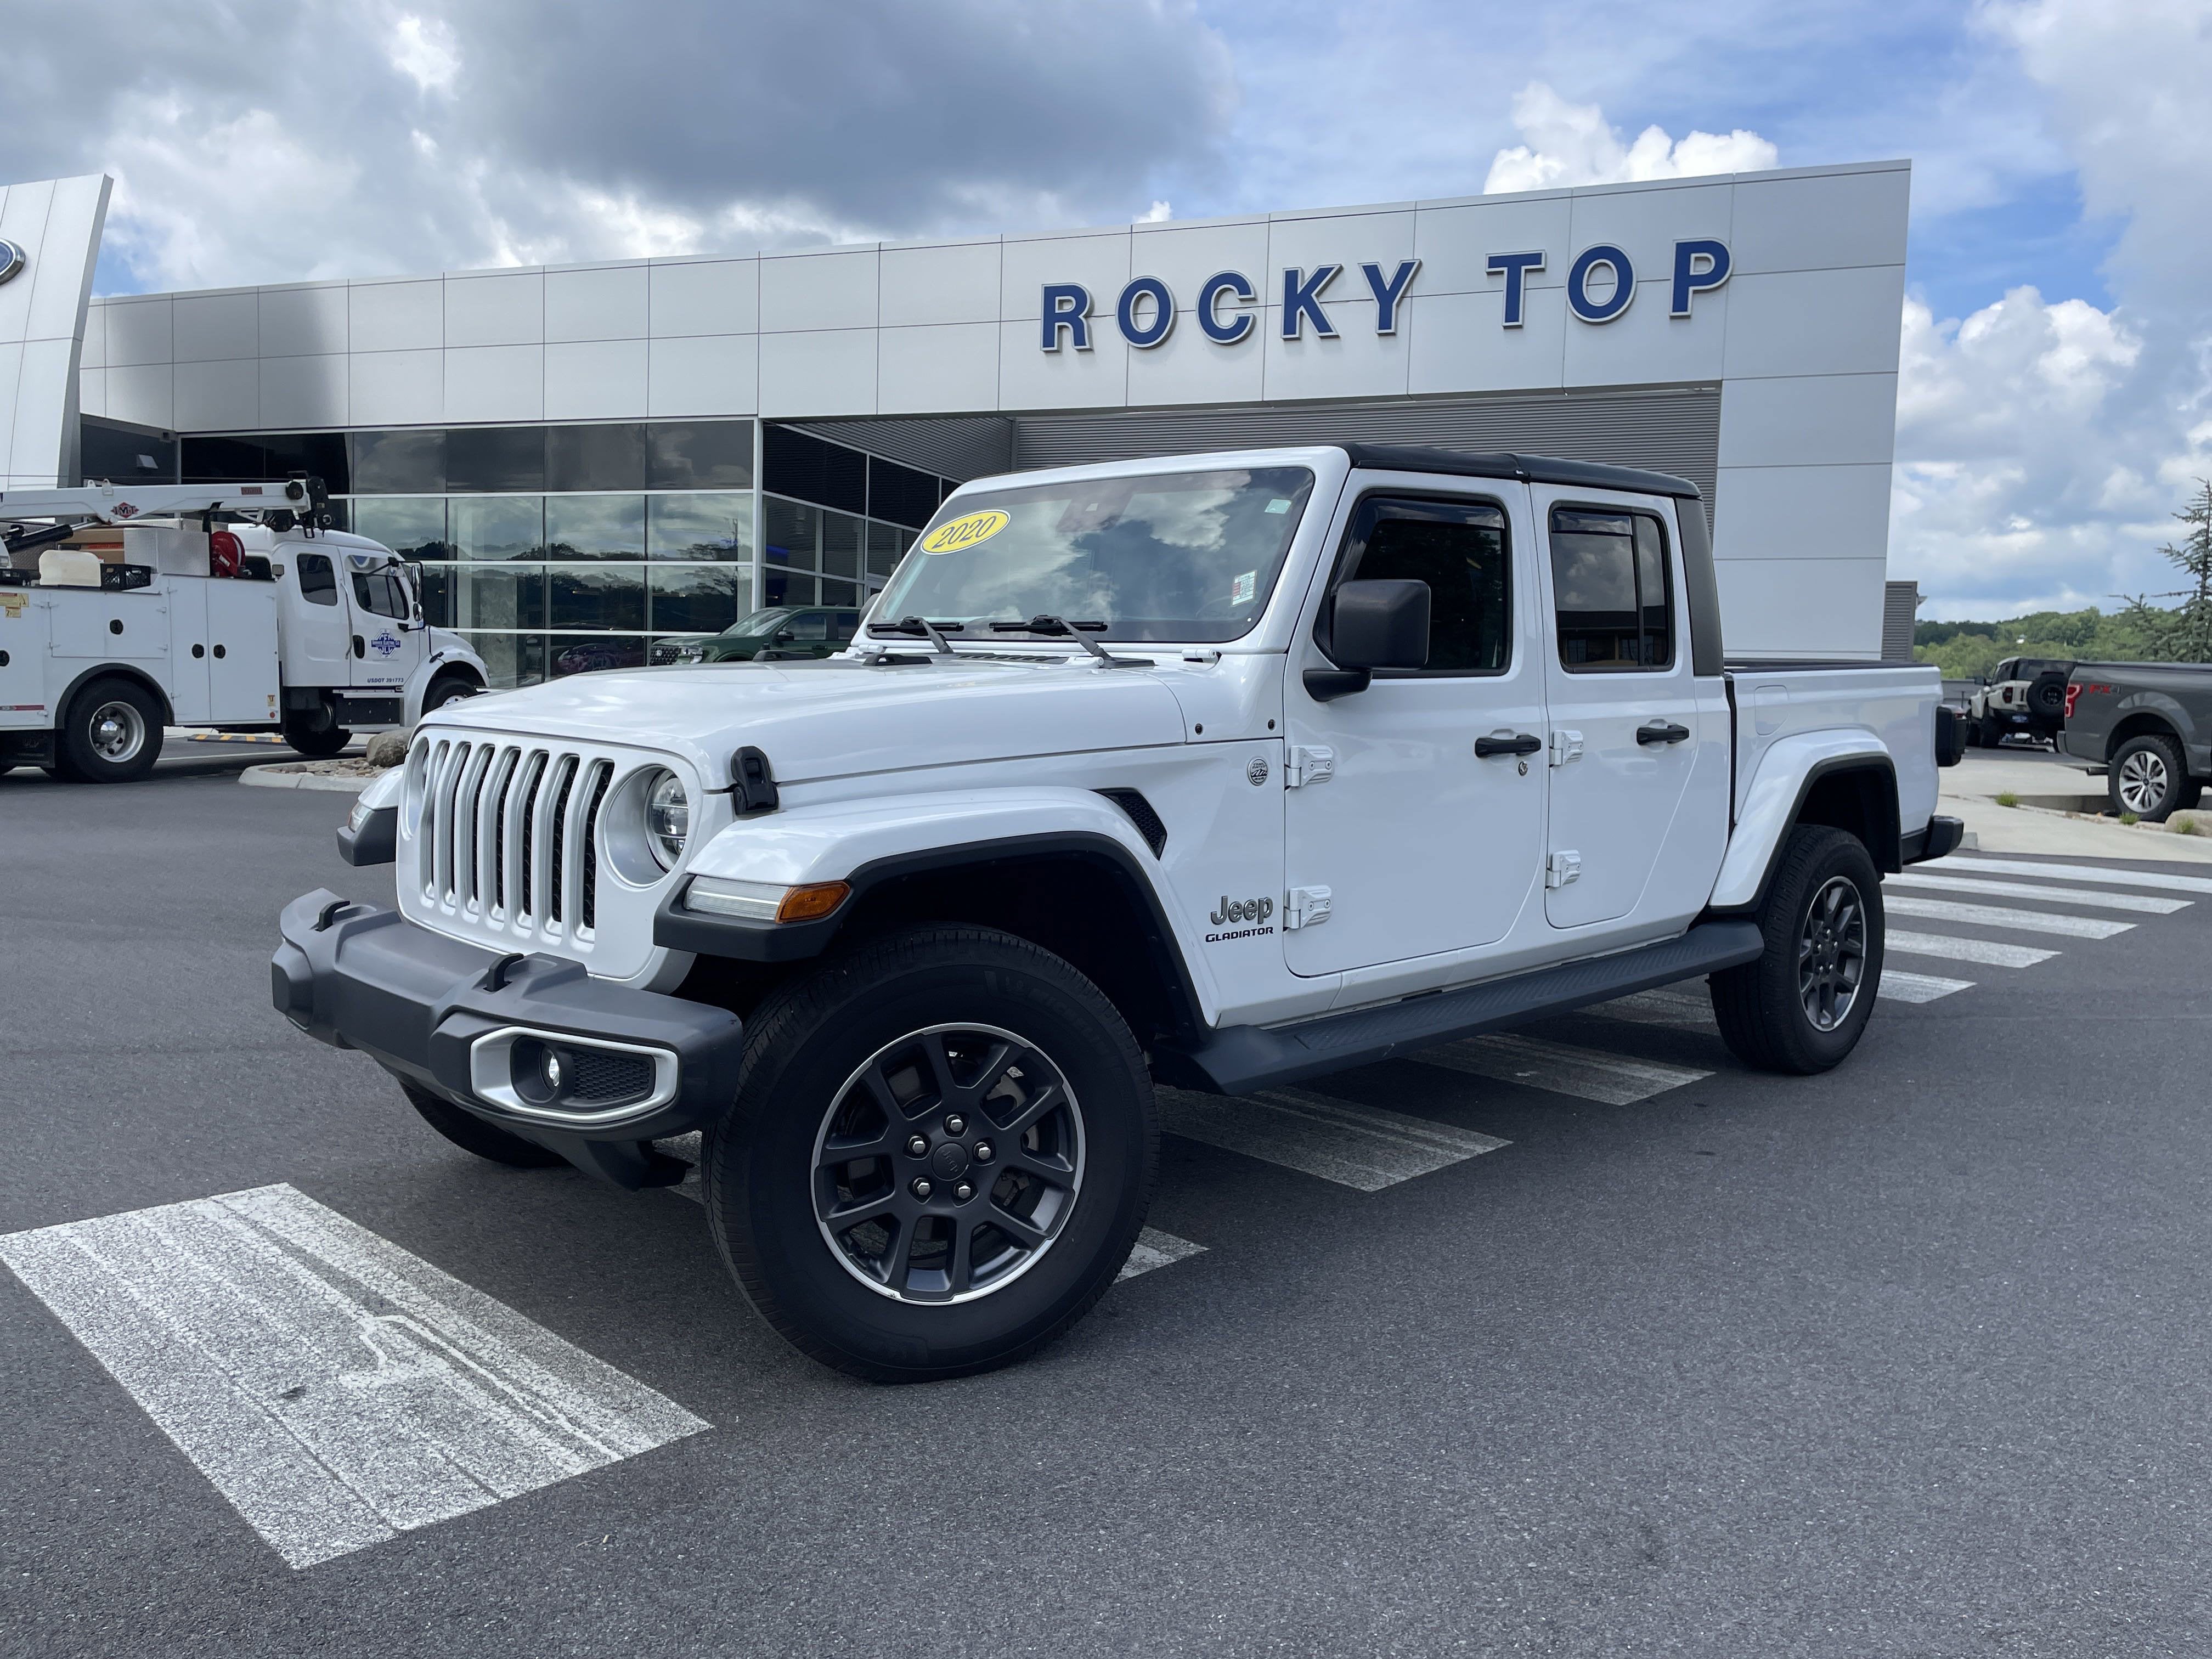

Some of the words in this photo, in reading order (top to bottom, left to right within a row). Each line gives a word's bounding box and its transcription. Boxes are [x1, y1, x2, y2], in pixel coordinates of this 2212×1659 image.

[1040, 258, 1422, 352] ROCKY
[1485, 237, 1733, 329] TOP
[113, 505, 136, 515] IMT
[932, 516, 997, 549] 2020
[1210, 895, 1273, 925] Jeep
[1205, 927, 1274, 943] GLADIATOR
[940, 1150, 958, 1172] Jeep
